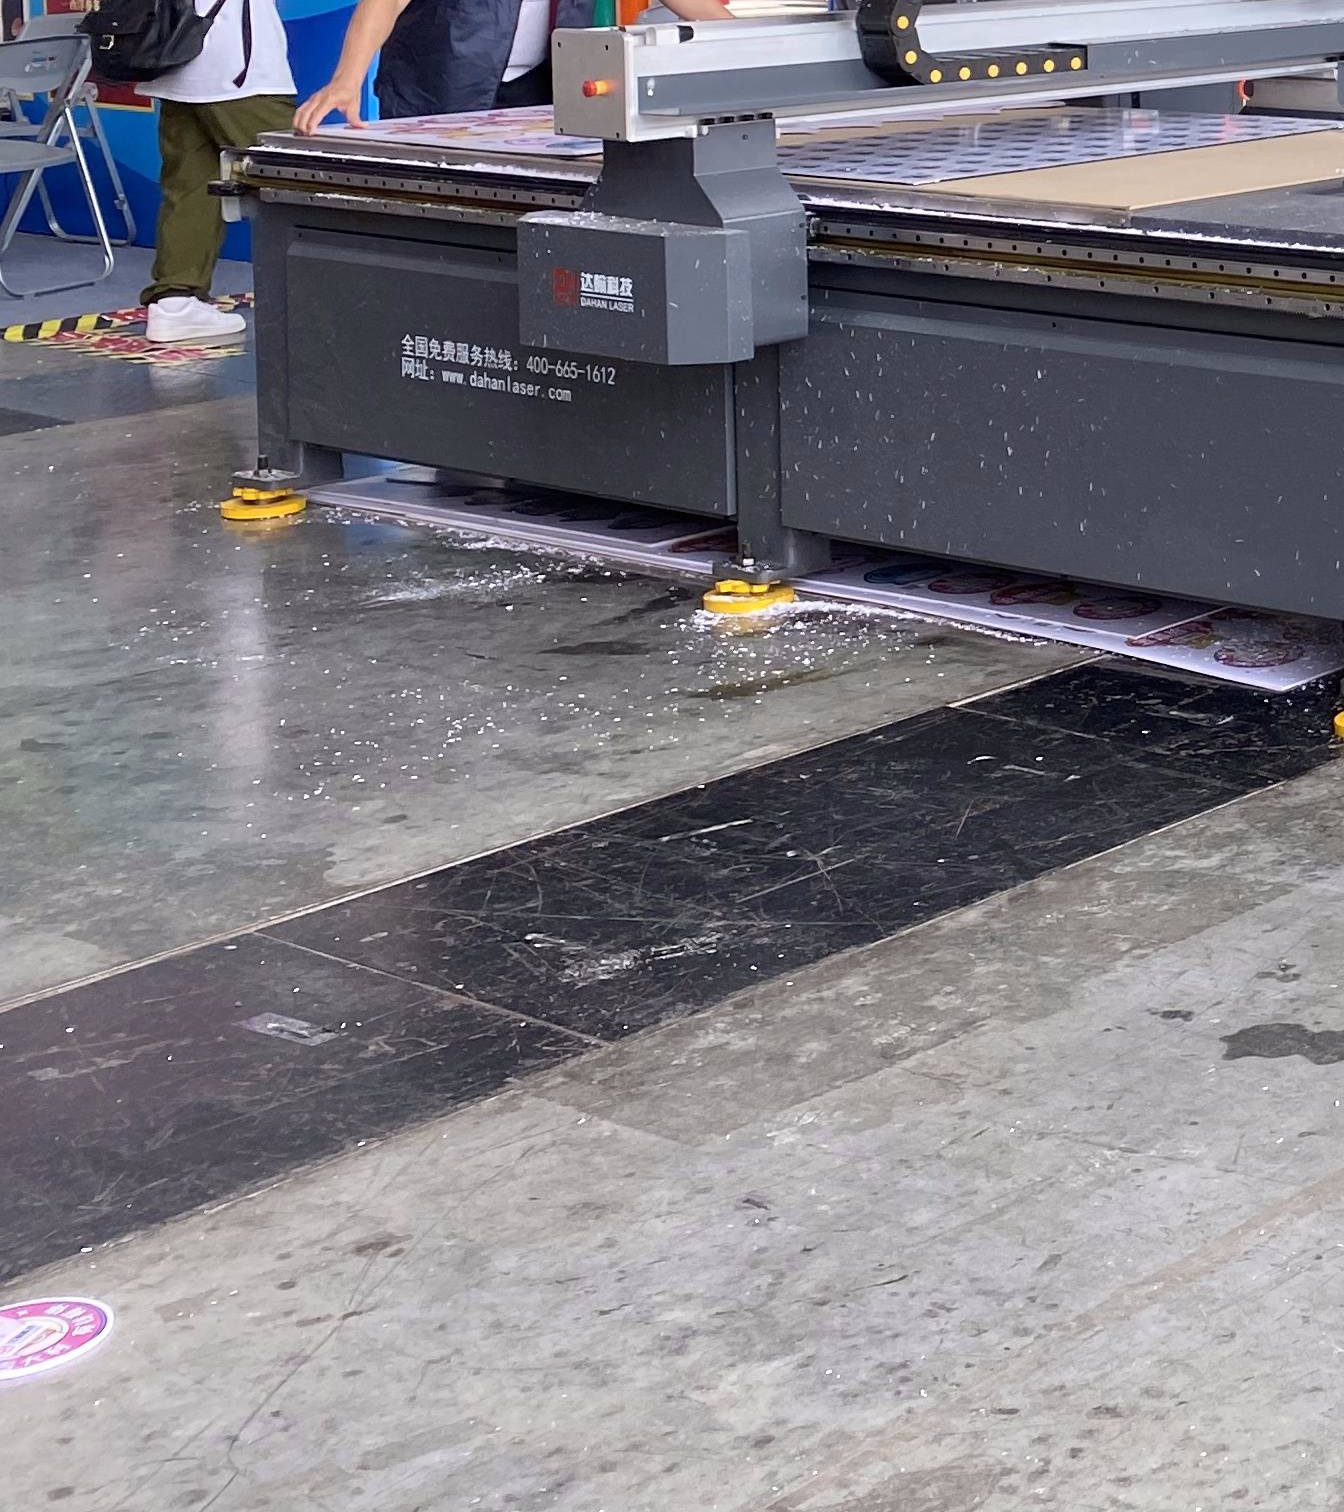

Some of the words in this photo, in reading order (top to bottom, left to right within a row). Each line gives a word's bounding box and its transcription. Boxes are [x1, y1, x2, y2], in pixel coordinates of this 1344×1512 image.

[581, 297, 608, 309] DAHAN
[609, 301, 634, 313] LASER
[401, 334, 518, 371] 全国免费服务热线：
[526, 356, 616, 385] 400-665-1612
[401, 357, 434, 380] 网址：
[442, 370, 572, 401] www.dahanlaser.com
